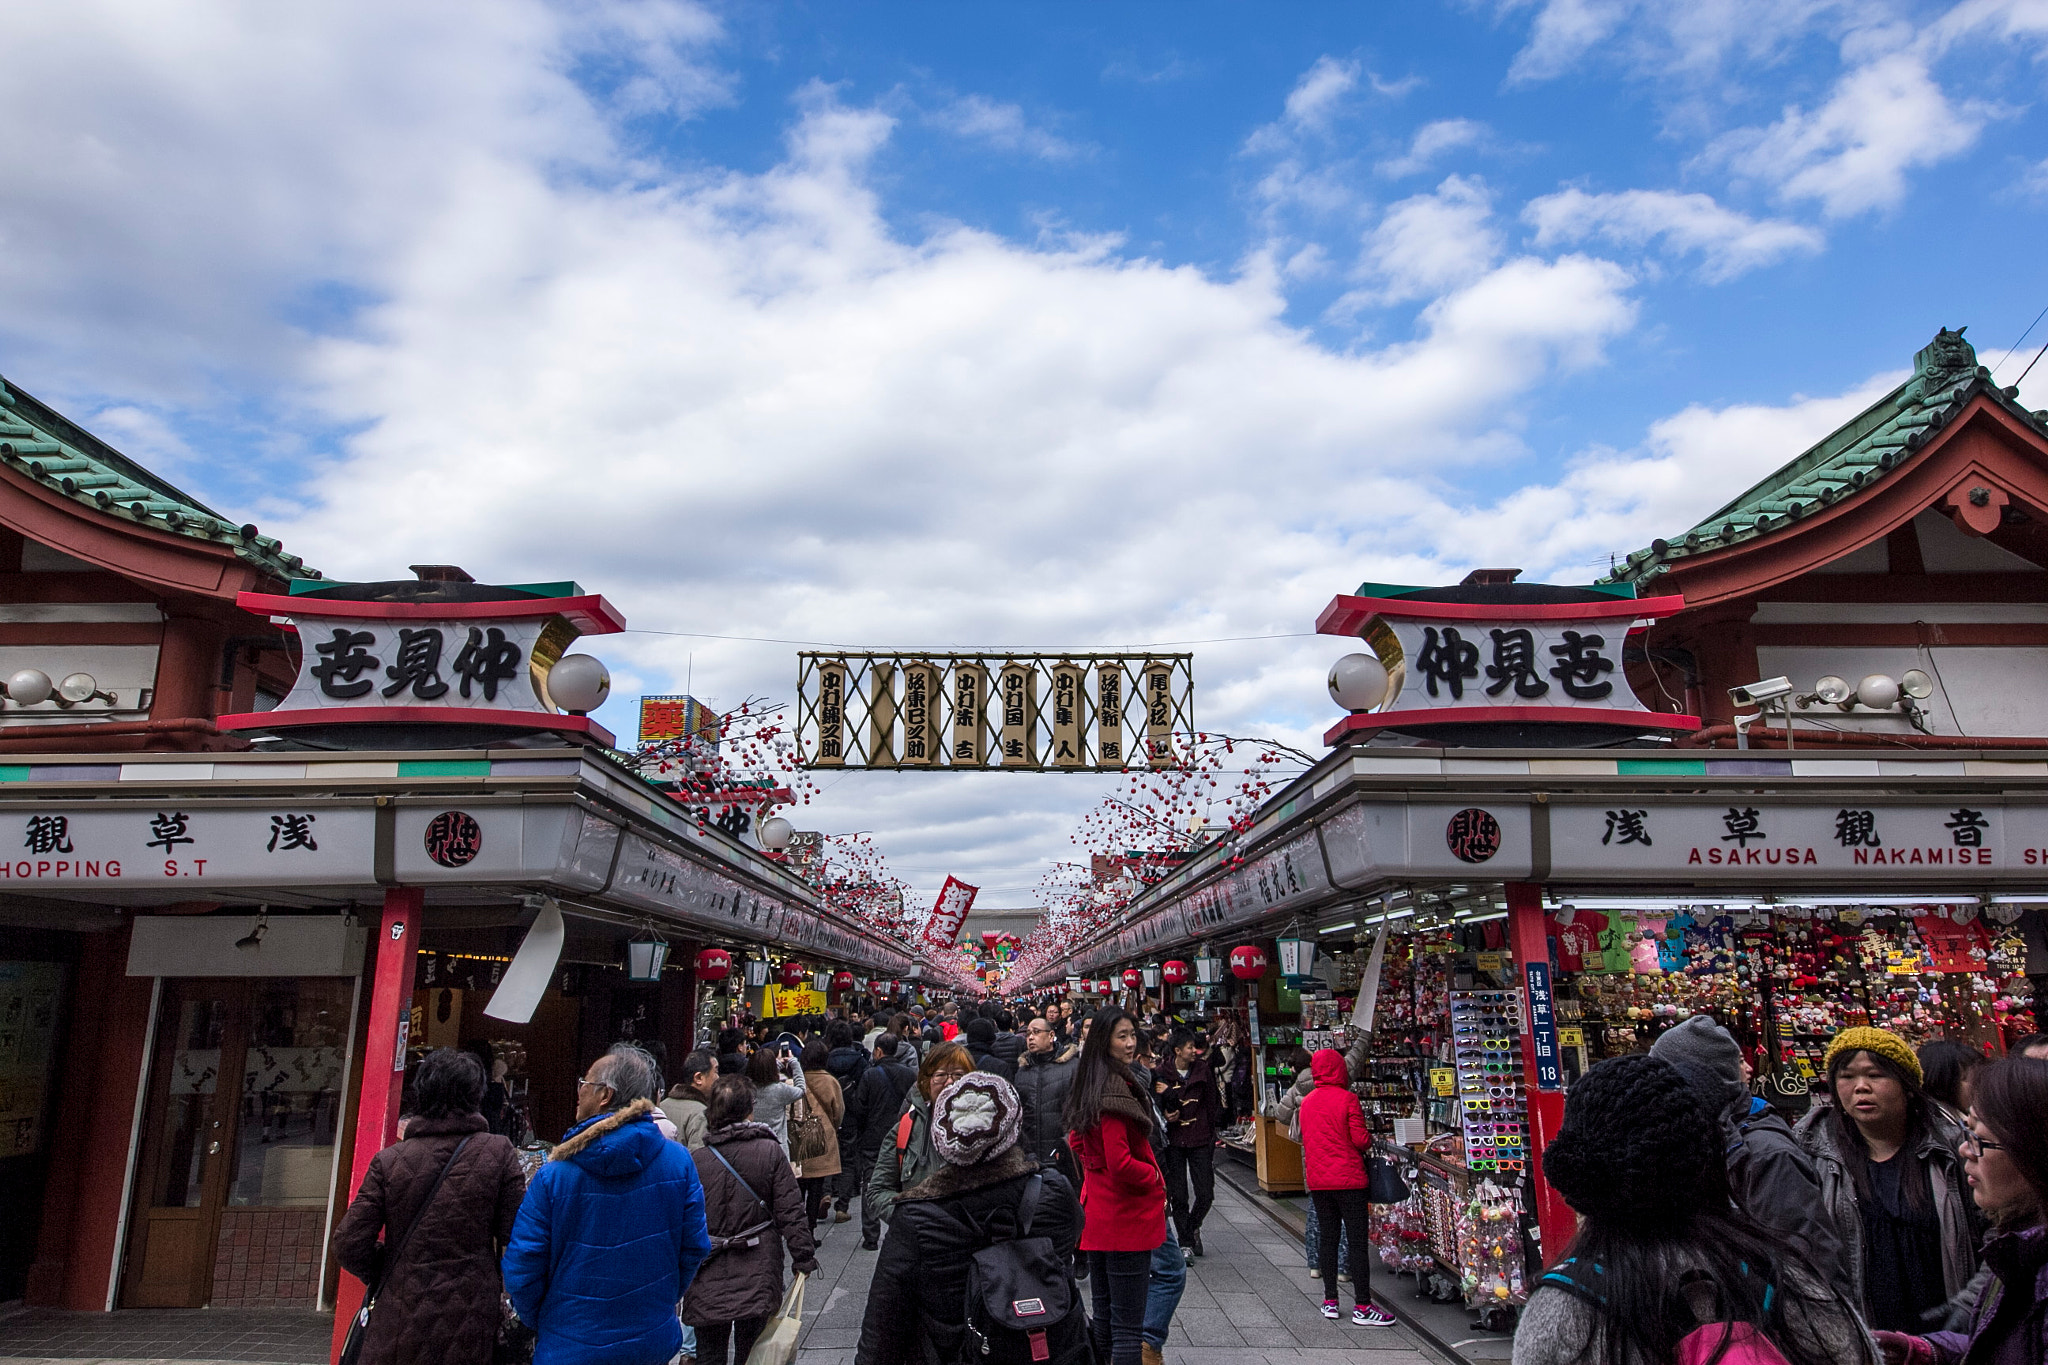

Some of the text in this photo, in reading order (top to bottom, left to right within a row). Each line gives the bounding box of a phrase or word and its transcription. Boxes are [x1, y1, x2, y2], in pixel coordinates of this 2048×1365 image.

[1416, 626, 1614, 699] 仲見世
[642, 702, 685, 736] 薬
[1688, 847, 1818, 865] ASAKUSA
[1854, 847, 1992, 865] NAKAMISE
[776, 993, 812, 1014] 半額
[1535, 989, 1551, 1057] 浅草一丁目
[1541, 1066, 1557, 1080] 18
